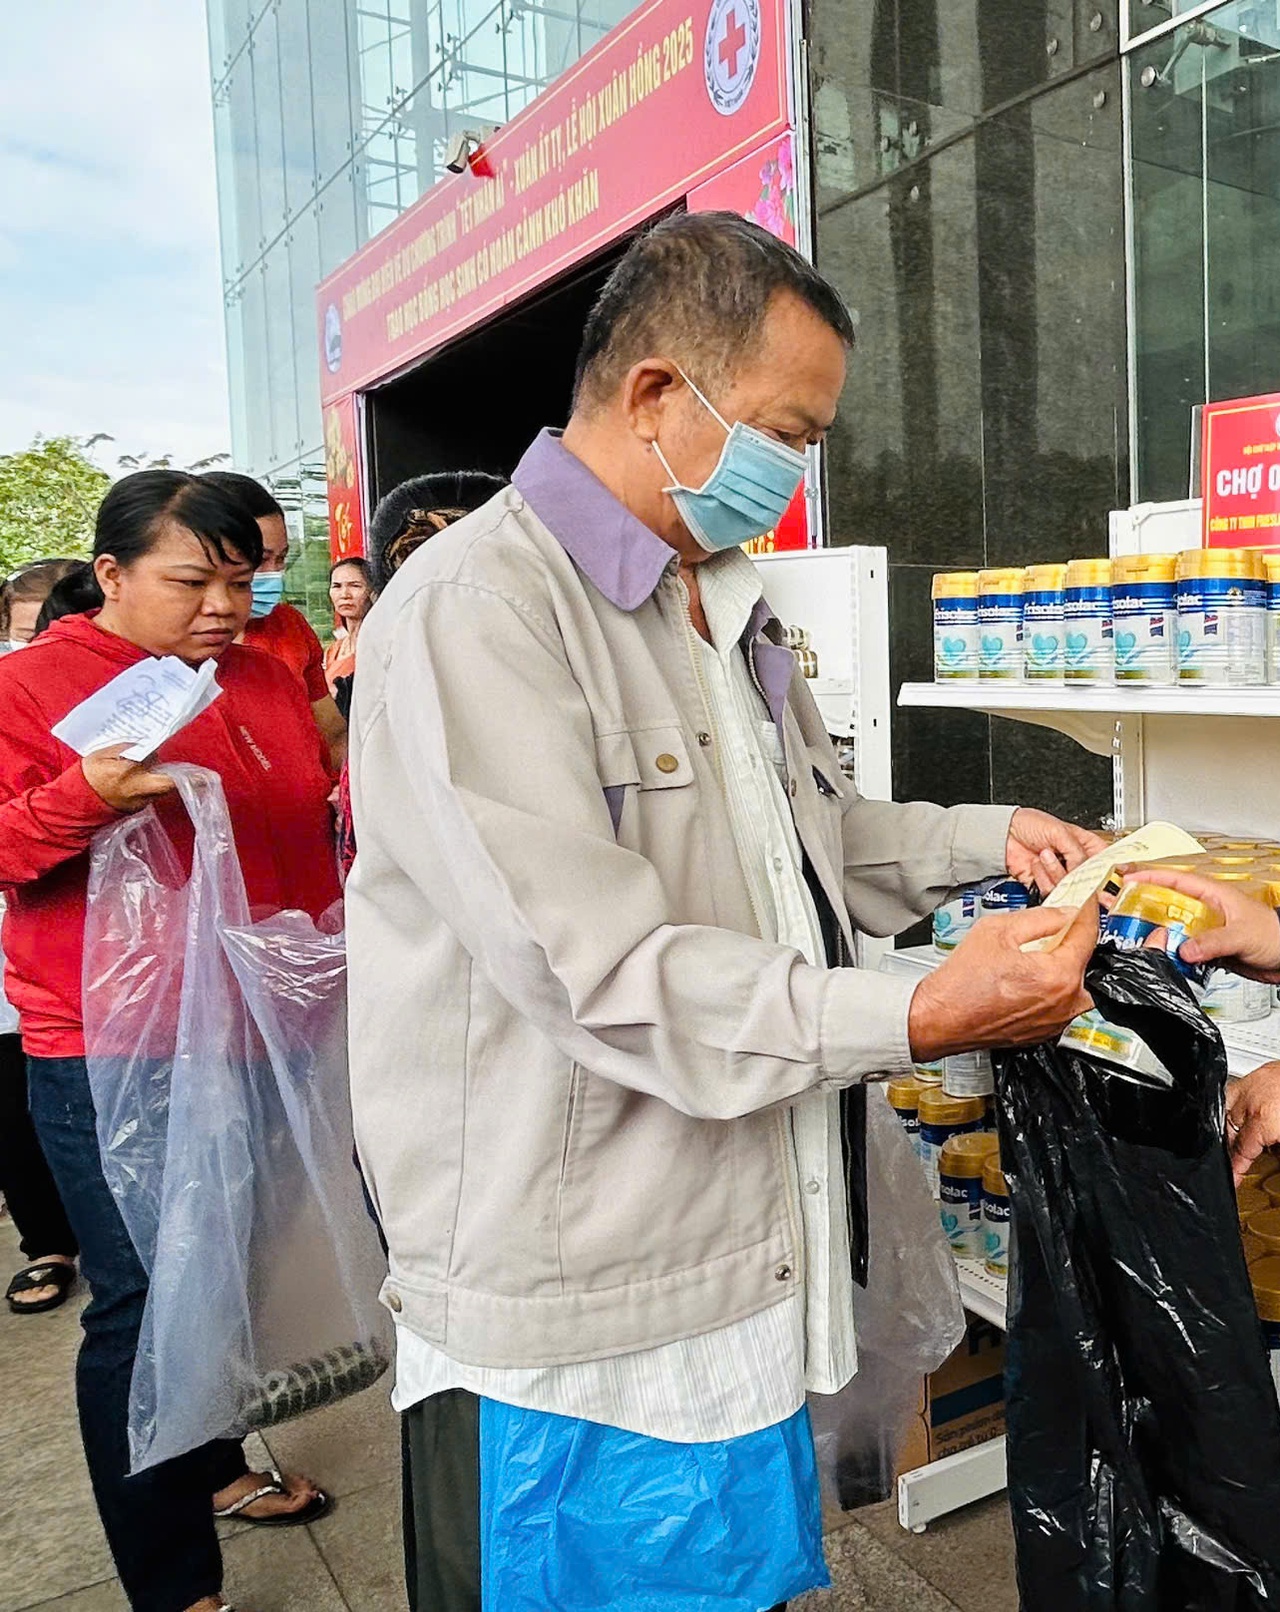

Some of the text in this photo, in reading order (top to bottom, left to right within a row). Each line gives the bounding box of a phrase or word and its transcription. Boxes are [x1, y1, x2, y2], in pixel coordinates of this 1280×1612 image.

[597, 70, 627, 130] XUÂN
[629, 42, 660, 107] HỒNG
[662, 15, 693, 81] 2025
[1216, 462, 1263, 499] CHỢ
[1229, 516, 1237, 530] TY
